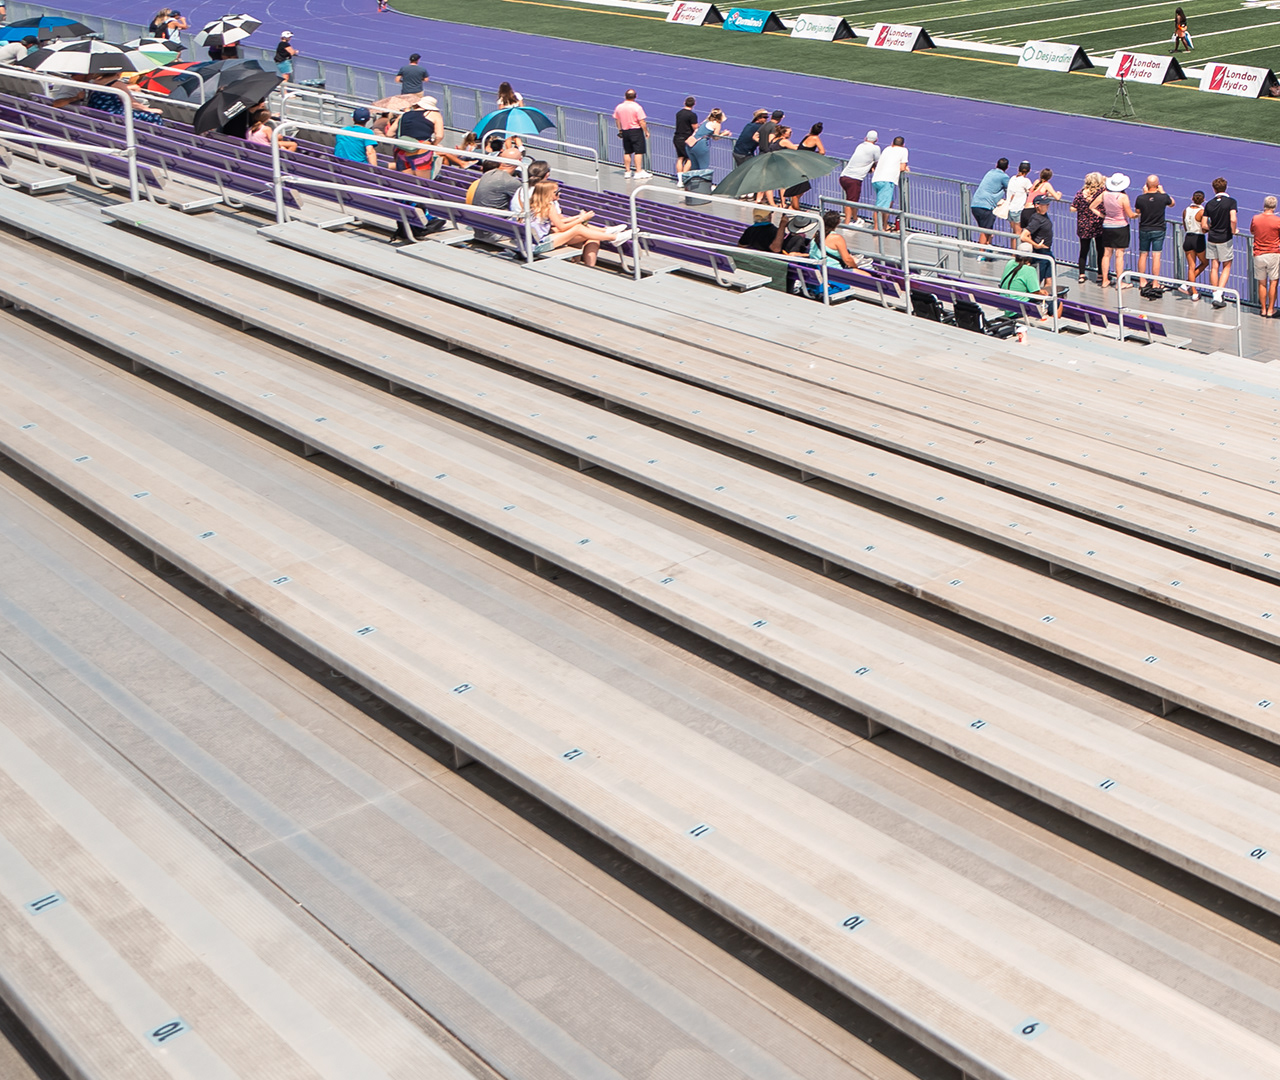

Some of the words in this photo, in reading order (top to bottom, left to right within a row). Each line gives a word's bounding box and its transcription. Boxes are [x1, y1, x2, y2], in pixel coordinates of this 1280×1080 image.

[889, 29, 913, 38] London
[886, 37, 905, 47] Hydro
[1133, 58, 1161, 69] London
[1130, 68, 1152, 79] Hydro
[1226, 70, 1257, 82] London
[1223, 80, 1248, 92] Hydro
[454, 685, 471, 693] 13
[564, 750, 582, 760] 12
[690, 825, 709, 836] 11
[1251, 849, 1266, 859] 10
[31, 895, 59, 911] 11
[843, 916, 864, 930] 10
[153, 1022, 183, 1042] 10
[1022, 1023, 1038, 1034] 9
